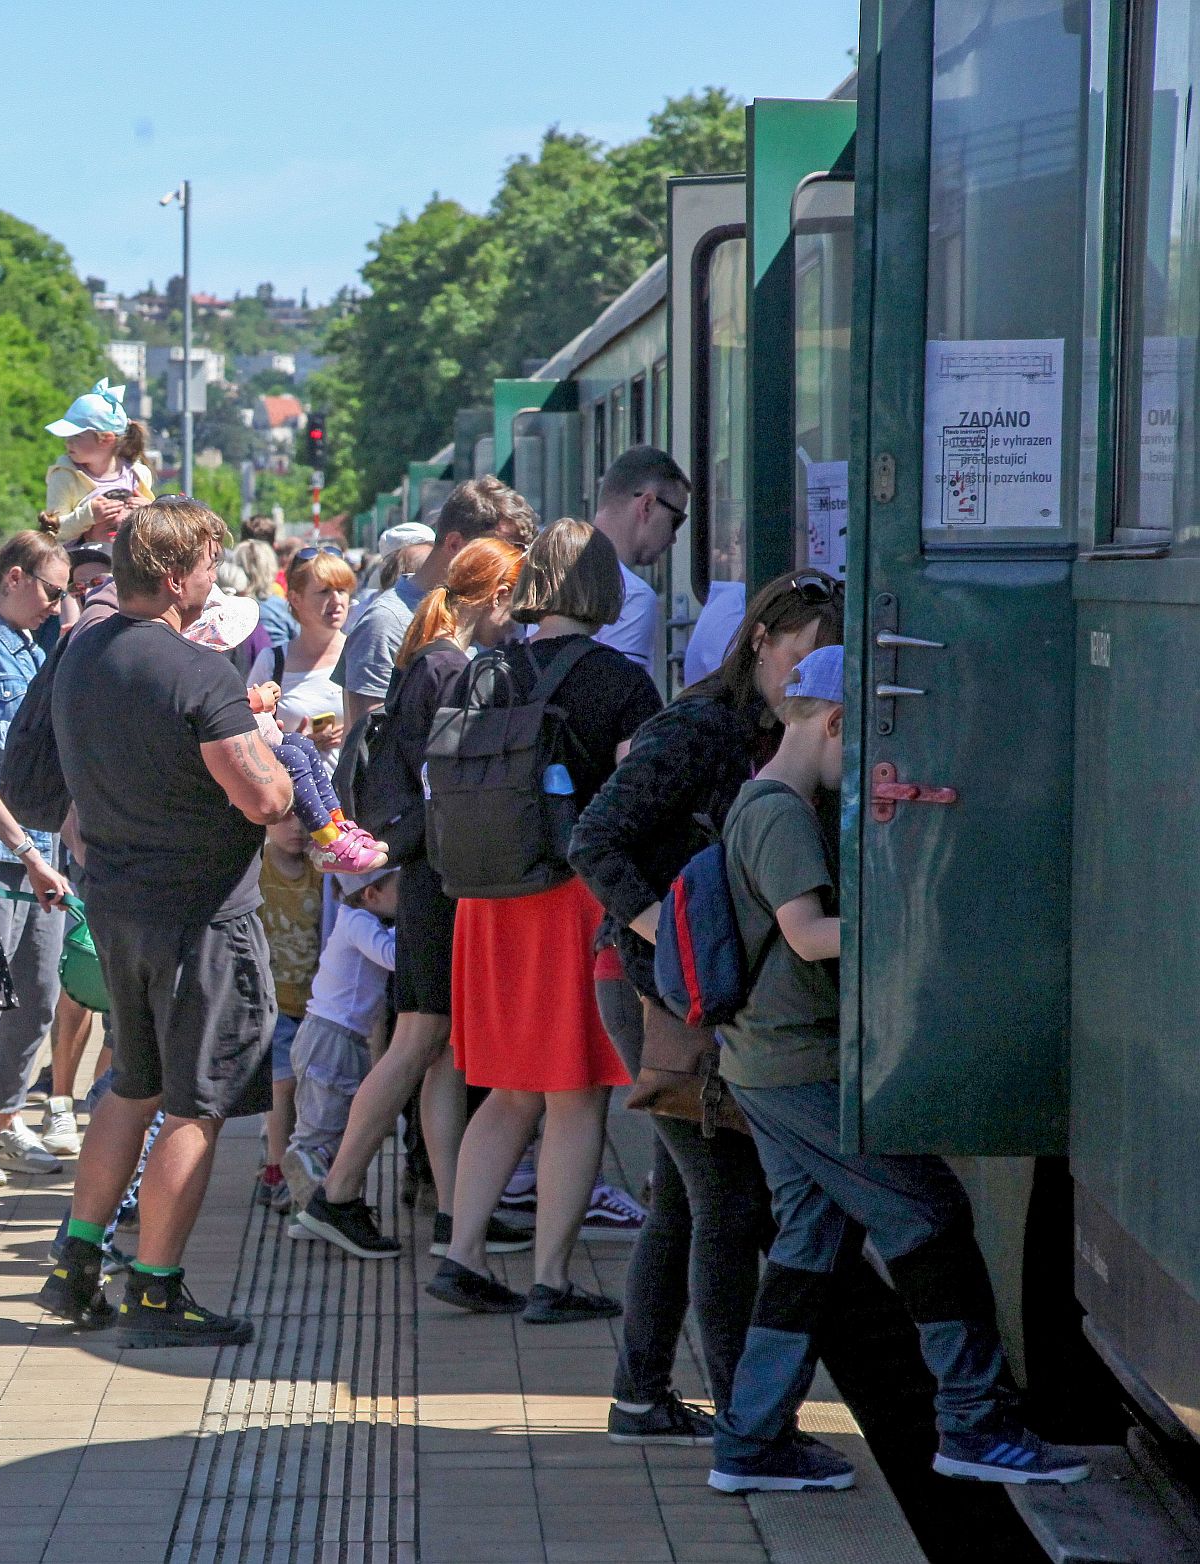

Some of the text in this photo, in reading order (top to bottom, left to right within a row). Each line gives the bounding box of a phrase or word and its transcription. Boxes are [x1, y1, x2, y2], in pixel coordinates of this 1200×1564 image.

[959, 407, 1031, 428] ZADÁNO
[990, 435, 1001, 448] je
[1003, 435, 1052, 448] vyhrazen
[960, 453, 1027, 467] pro cestující
[935, 474, 947, 483] se
[994, 471, 1052, 485] pozvánkou
